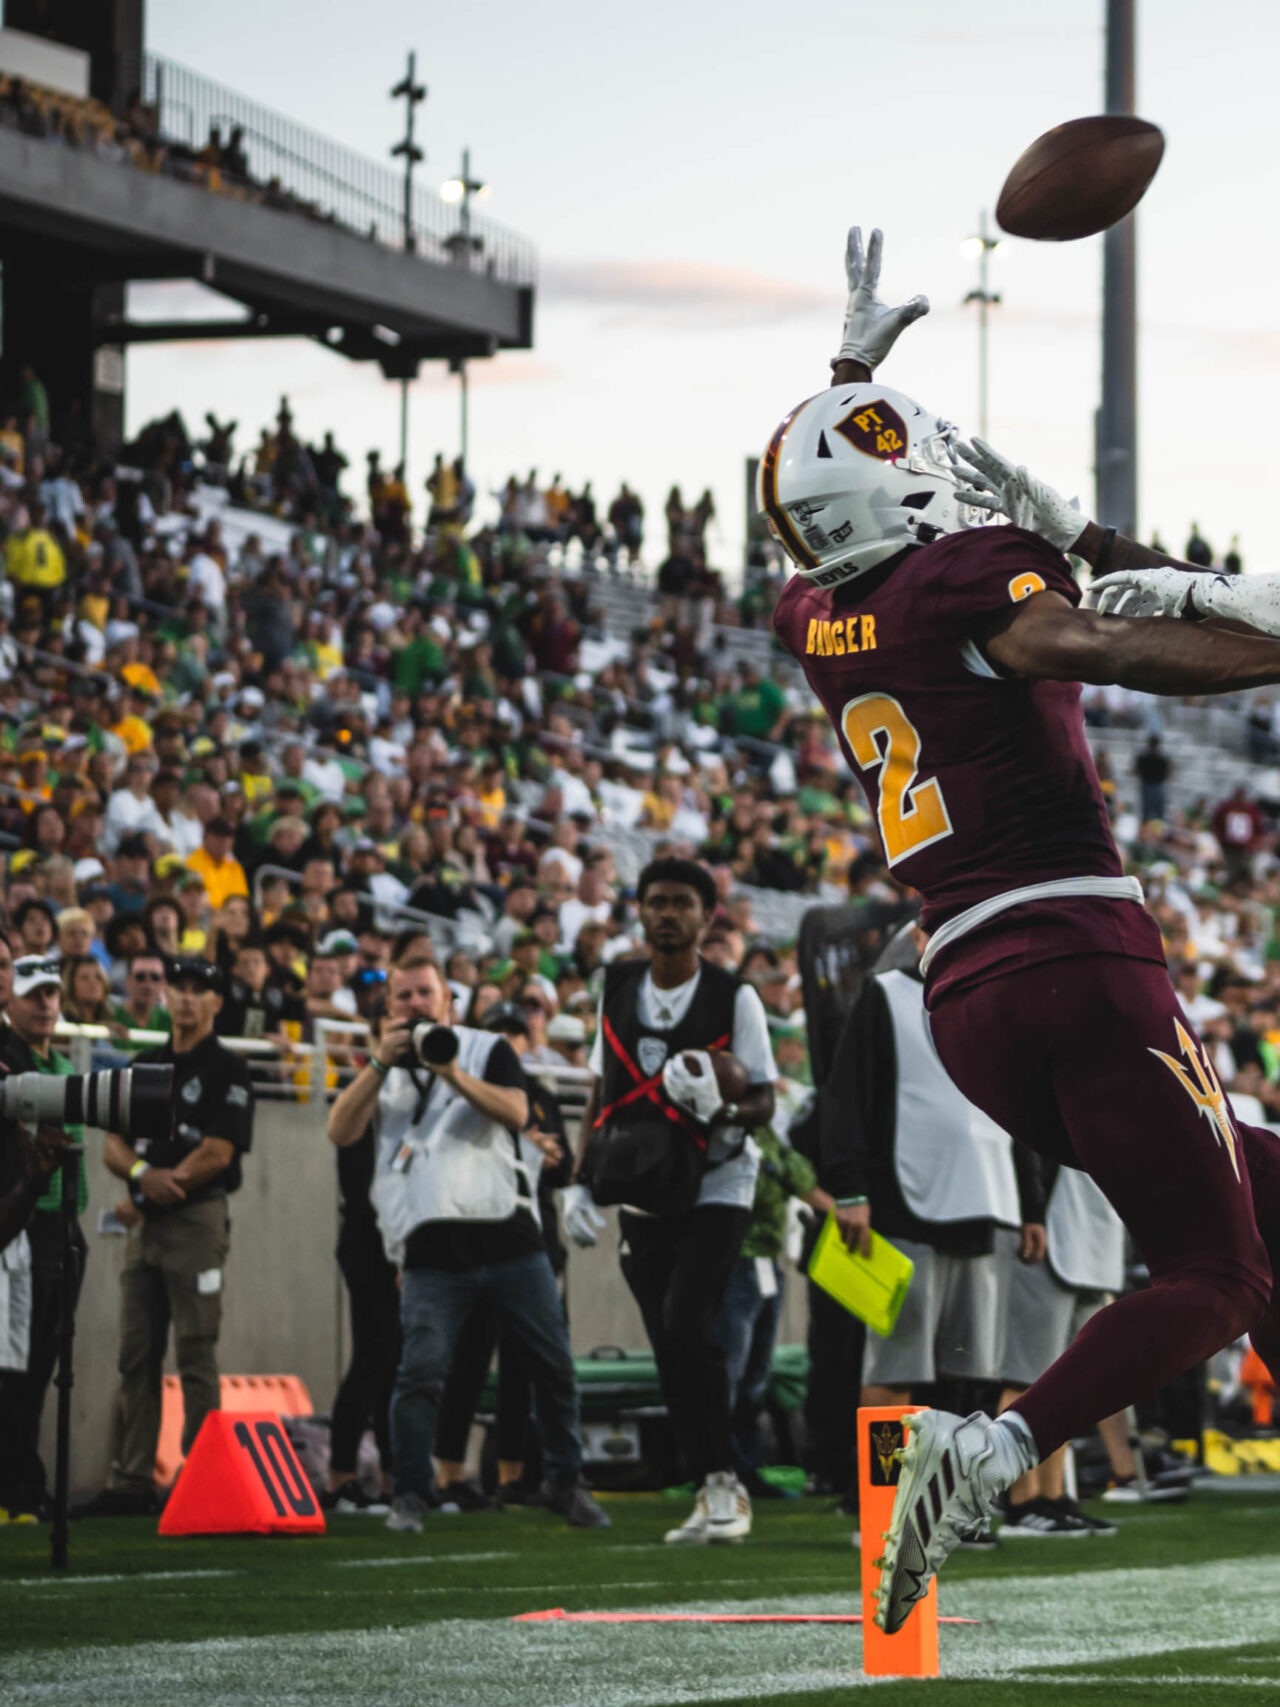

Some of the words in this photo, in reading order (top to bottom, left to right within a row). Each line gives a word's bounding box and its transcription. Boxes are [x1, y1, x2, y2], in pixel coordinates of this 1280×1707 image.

[853, 408, 883, 432] PT
[876, 429, 903, 453] 42
[842, 692, 954, 869] 2
[234, 1421, 316, 1517] 10
